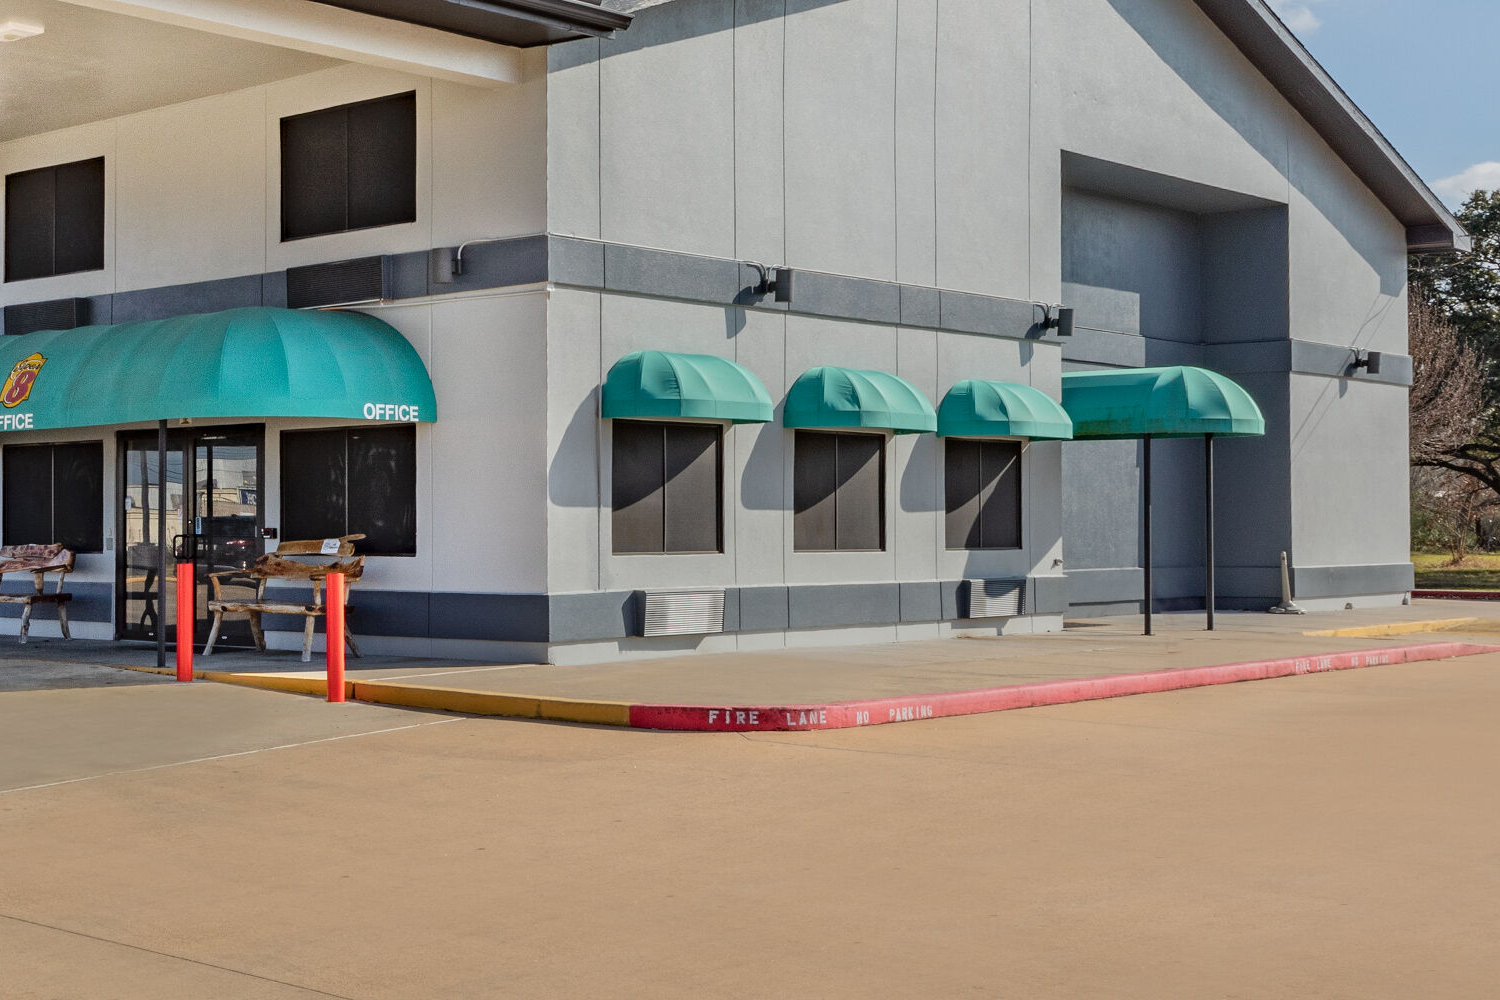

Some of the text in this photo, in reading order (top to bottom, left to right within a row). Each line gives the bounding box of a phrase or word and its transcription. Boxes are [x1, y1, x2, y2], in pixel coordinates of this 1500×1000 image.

[4, 370, 37, 404] 8
[363, 402, 420, 422] OFFICE
[708, 705, 934, 726] FIRE LANE NO PARKING
